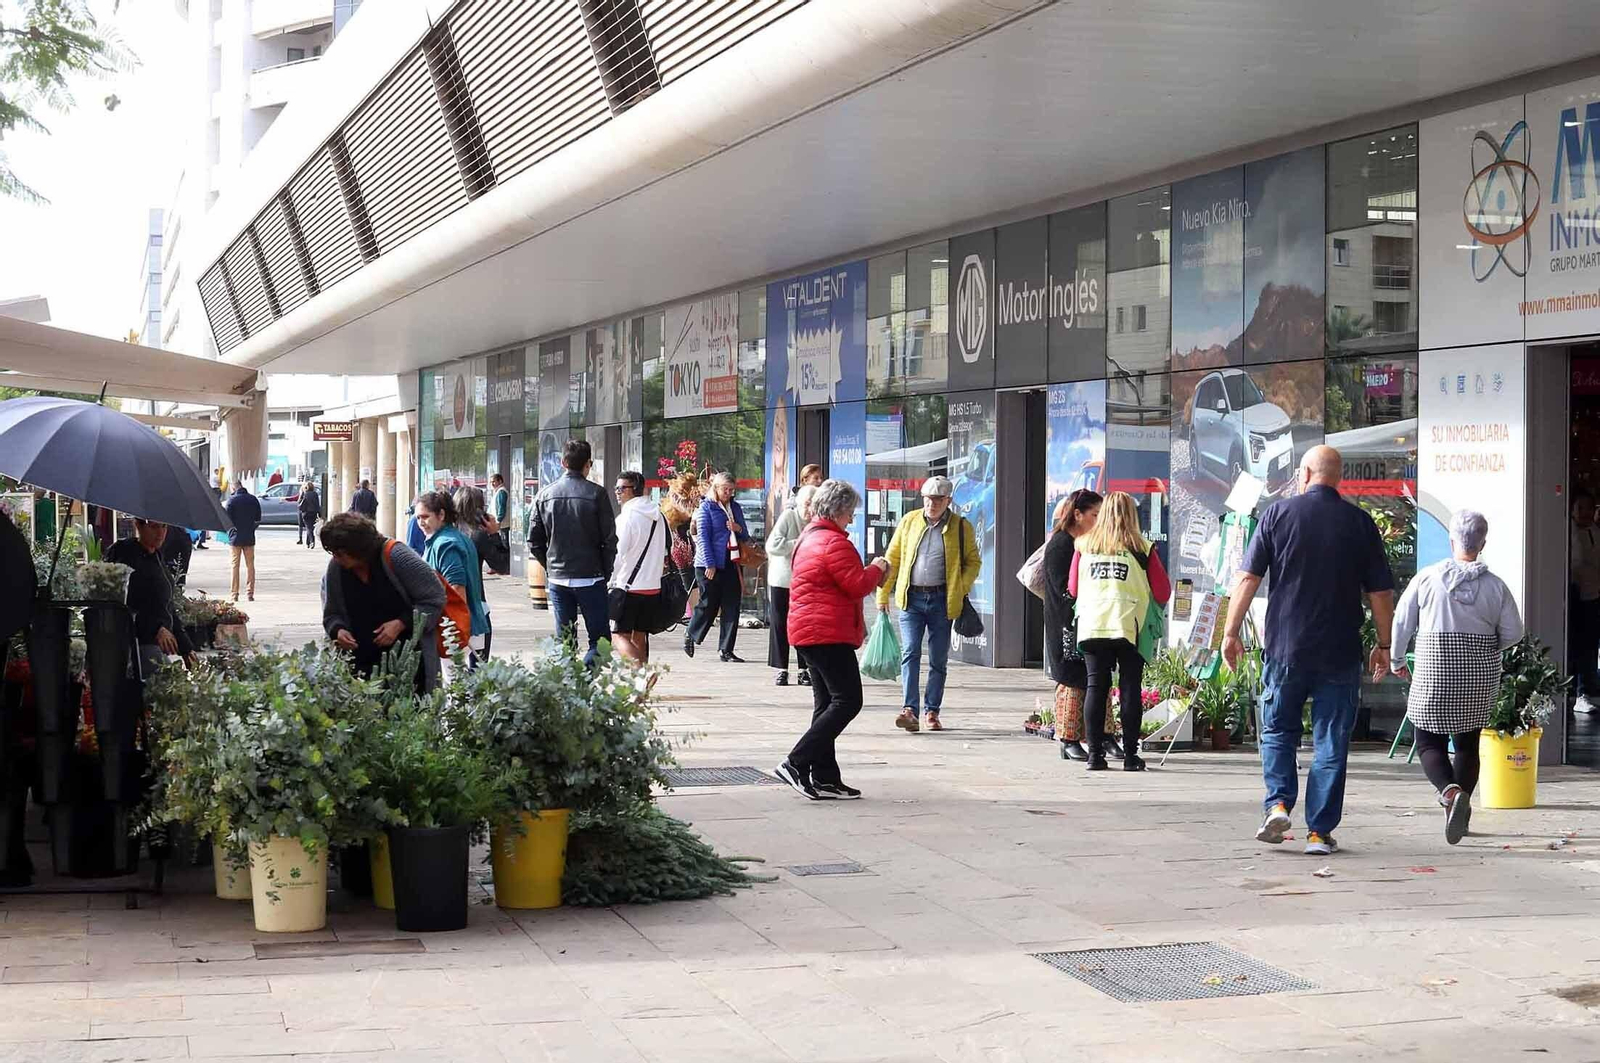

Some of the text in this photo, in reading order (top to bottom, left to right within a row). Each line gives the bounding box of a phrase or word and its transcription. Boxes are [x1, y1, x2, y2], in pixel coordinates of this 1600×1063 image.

[1182, 207, 1210, 231] Nuevo
[1212, 201, 1226, 225] Kia
[1550, 254, 1578, 272] GRUPO
[783, 271, 847, 309] VITALDENT
[999, 267, 1098, 329] Motor Inglés
[959, 262, 984, 356] MG
[669, 360, 701, 397] TOKYO
[324, 423, 352, 432] TABACOS
[1432, 423, 1509, 443] SU INMOBILIARIA
[1435, 453, 1505, 472] DE CONFIANZA
[1099, 569, 1126, 579] ONCE
